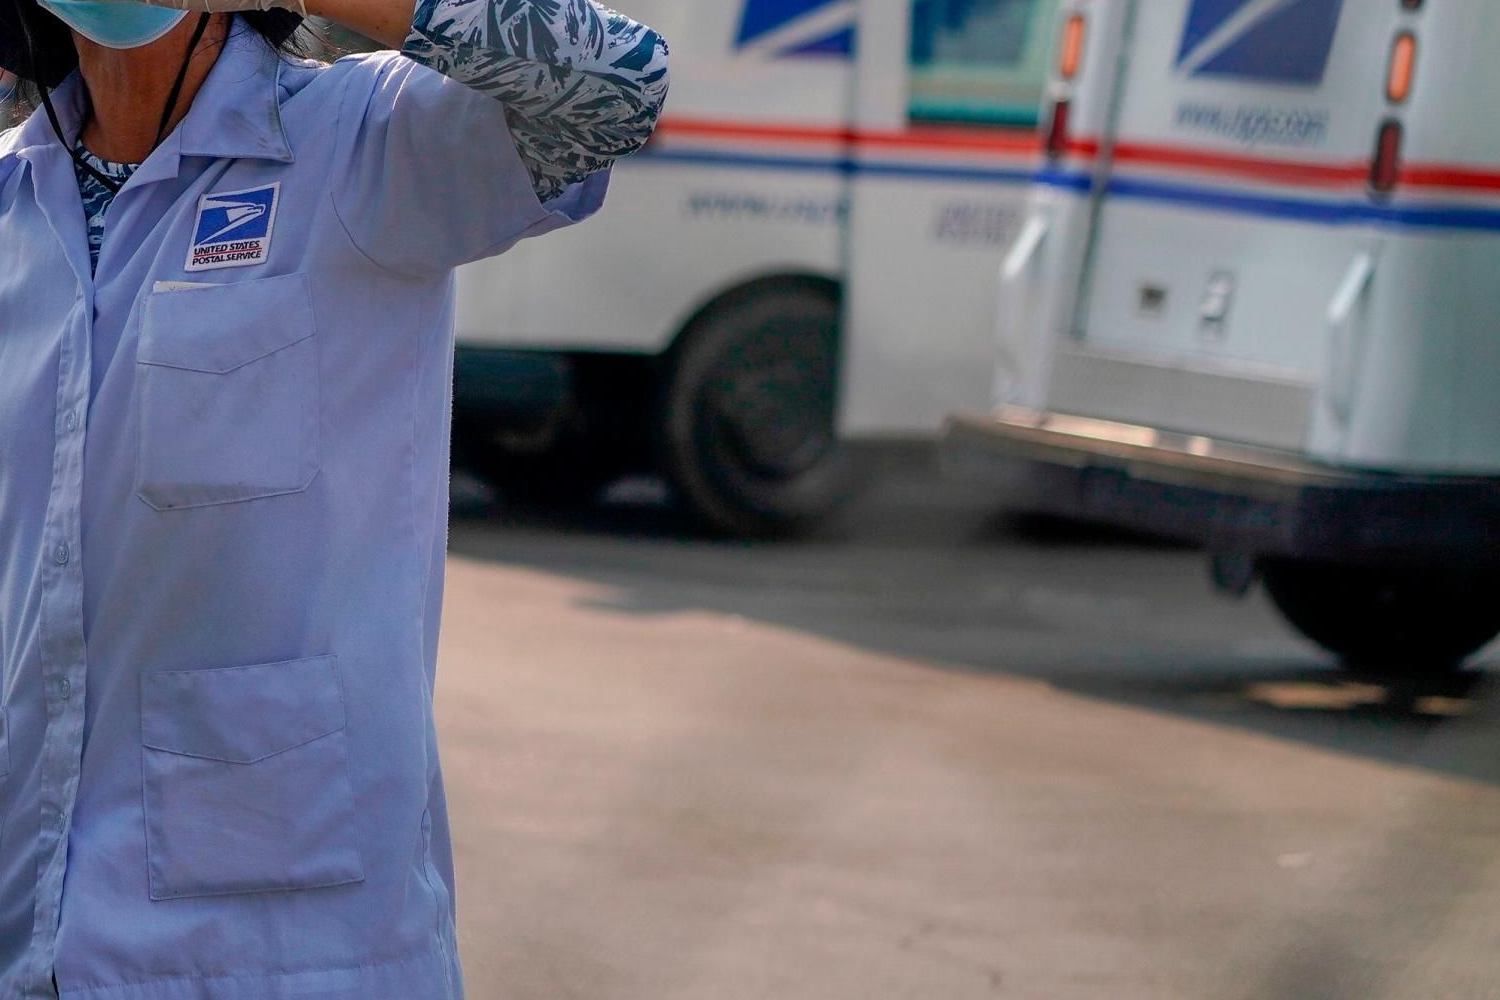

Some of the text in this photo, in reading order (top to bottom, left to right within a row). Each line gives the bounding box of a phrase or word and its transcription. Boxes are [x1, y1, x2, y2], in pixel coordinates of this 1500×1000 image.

[194, 240, 260, 255] UNITED STATES
[192, 251, 261, 266] POSTAL SERVICE
